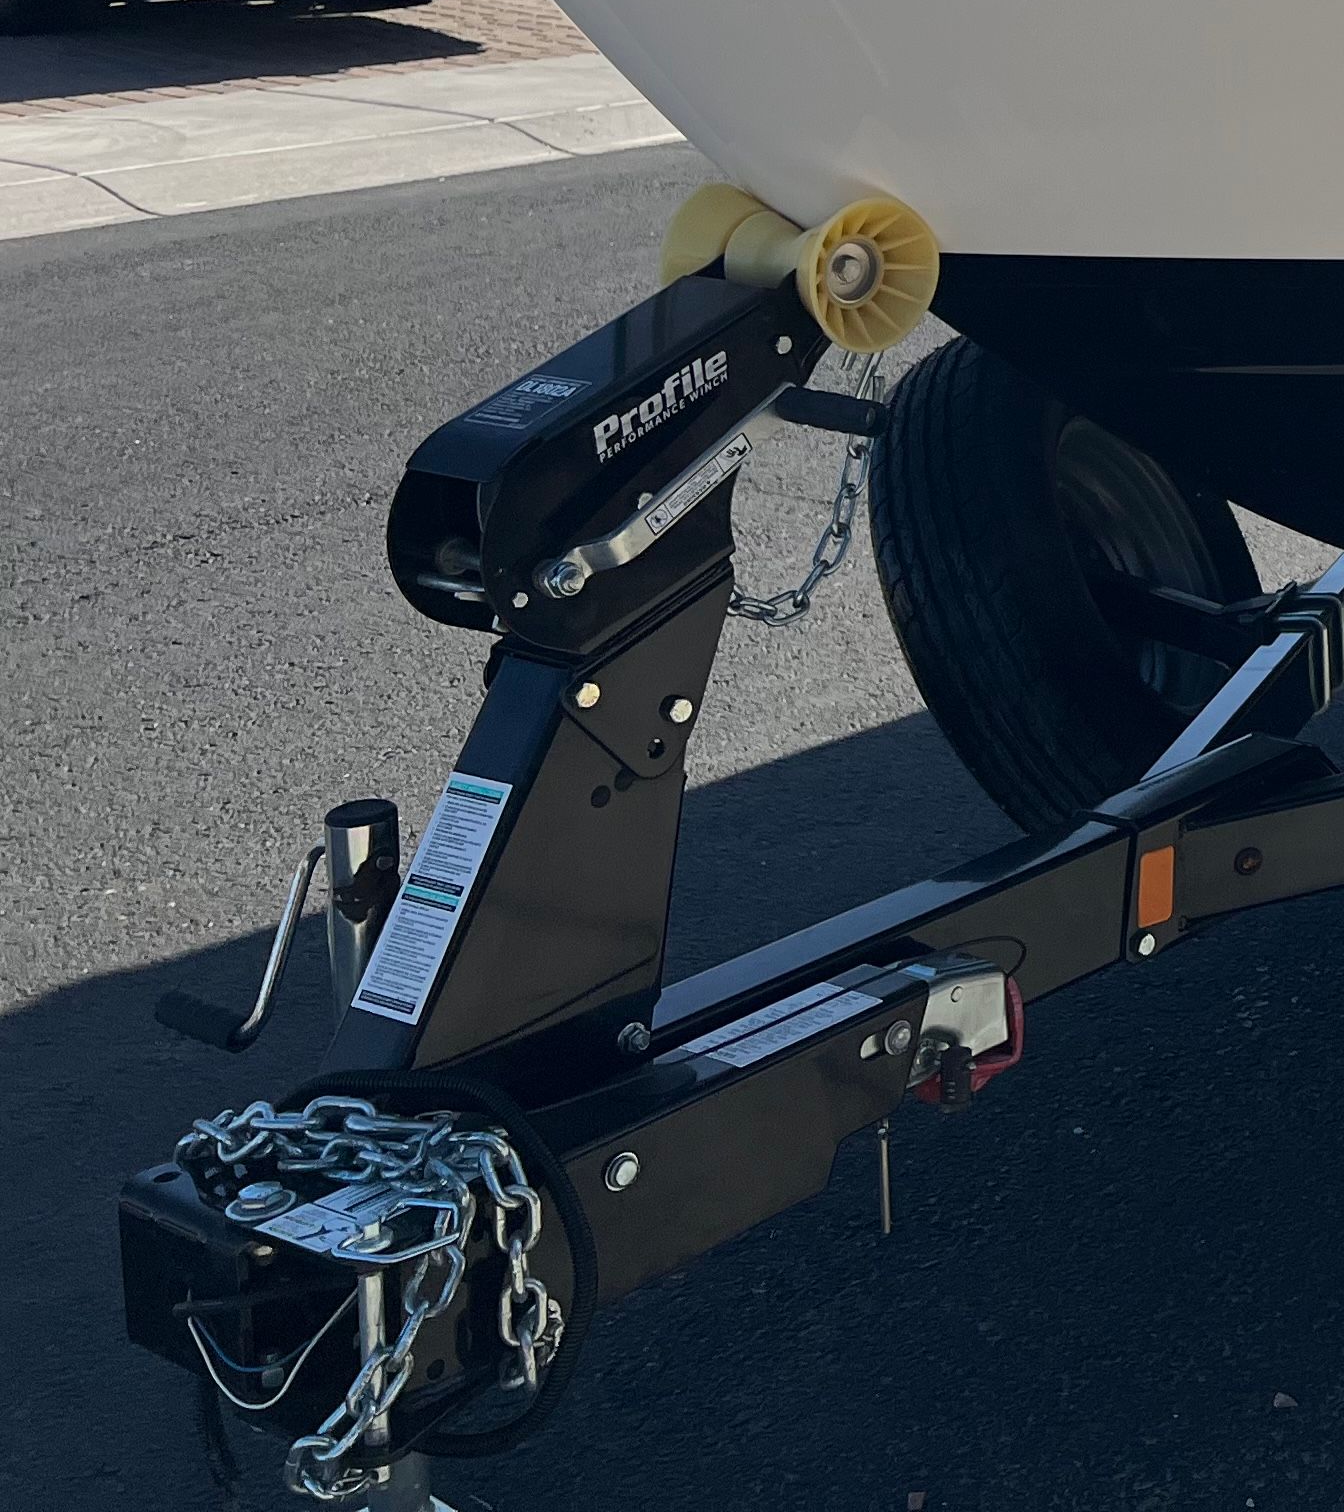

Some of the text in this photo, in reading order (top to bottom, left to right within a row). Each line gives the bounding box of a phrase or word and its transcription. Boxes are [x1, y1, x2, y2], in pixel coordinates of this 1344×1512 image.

[593, 350, 728, 455] Profile
[599, 399, 686, 464] PERFORMANCE
[690, 370, 729, 403] WINCH
